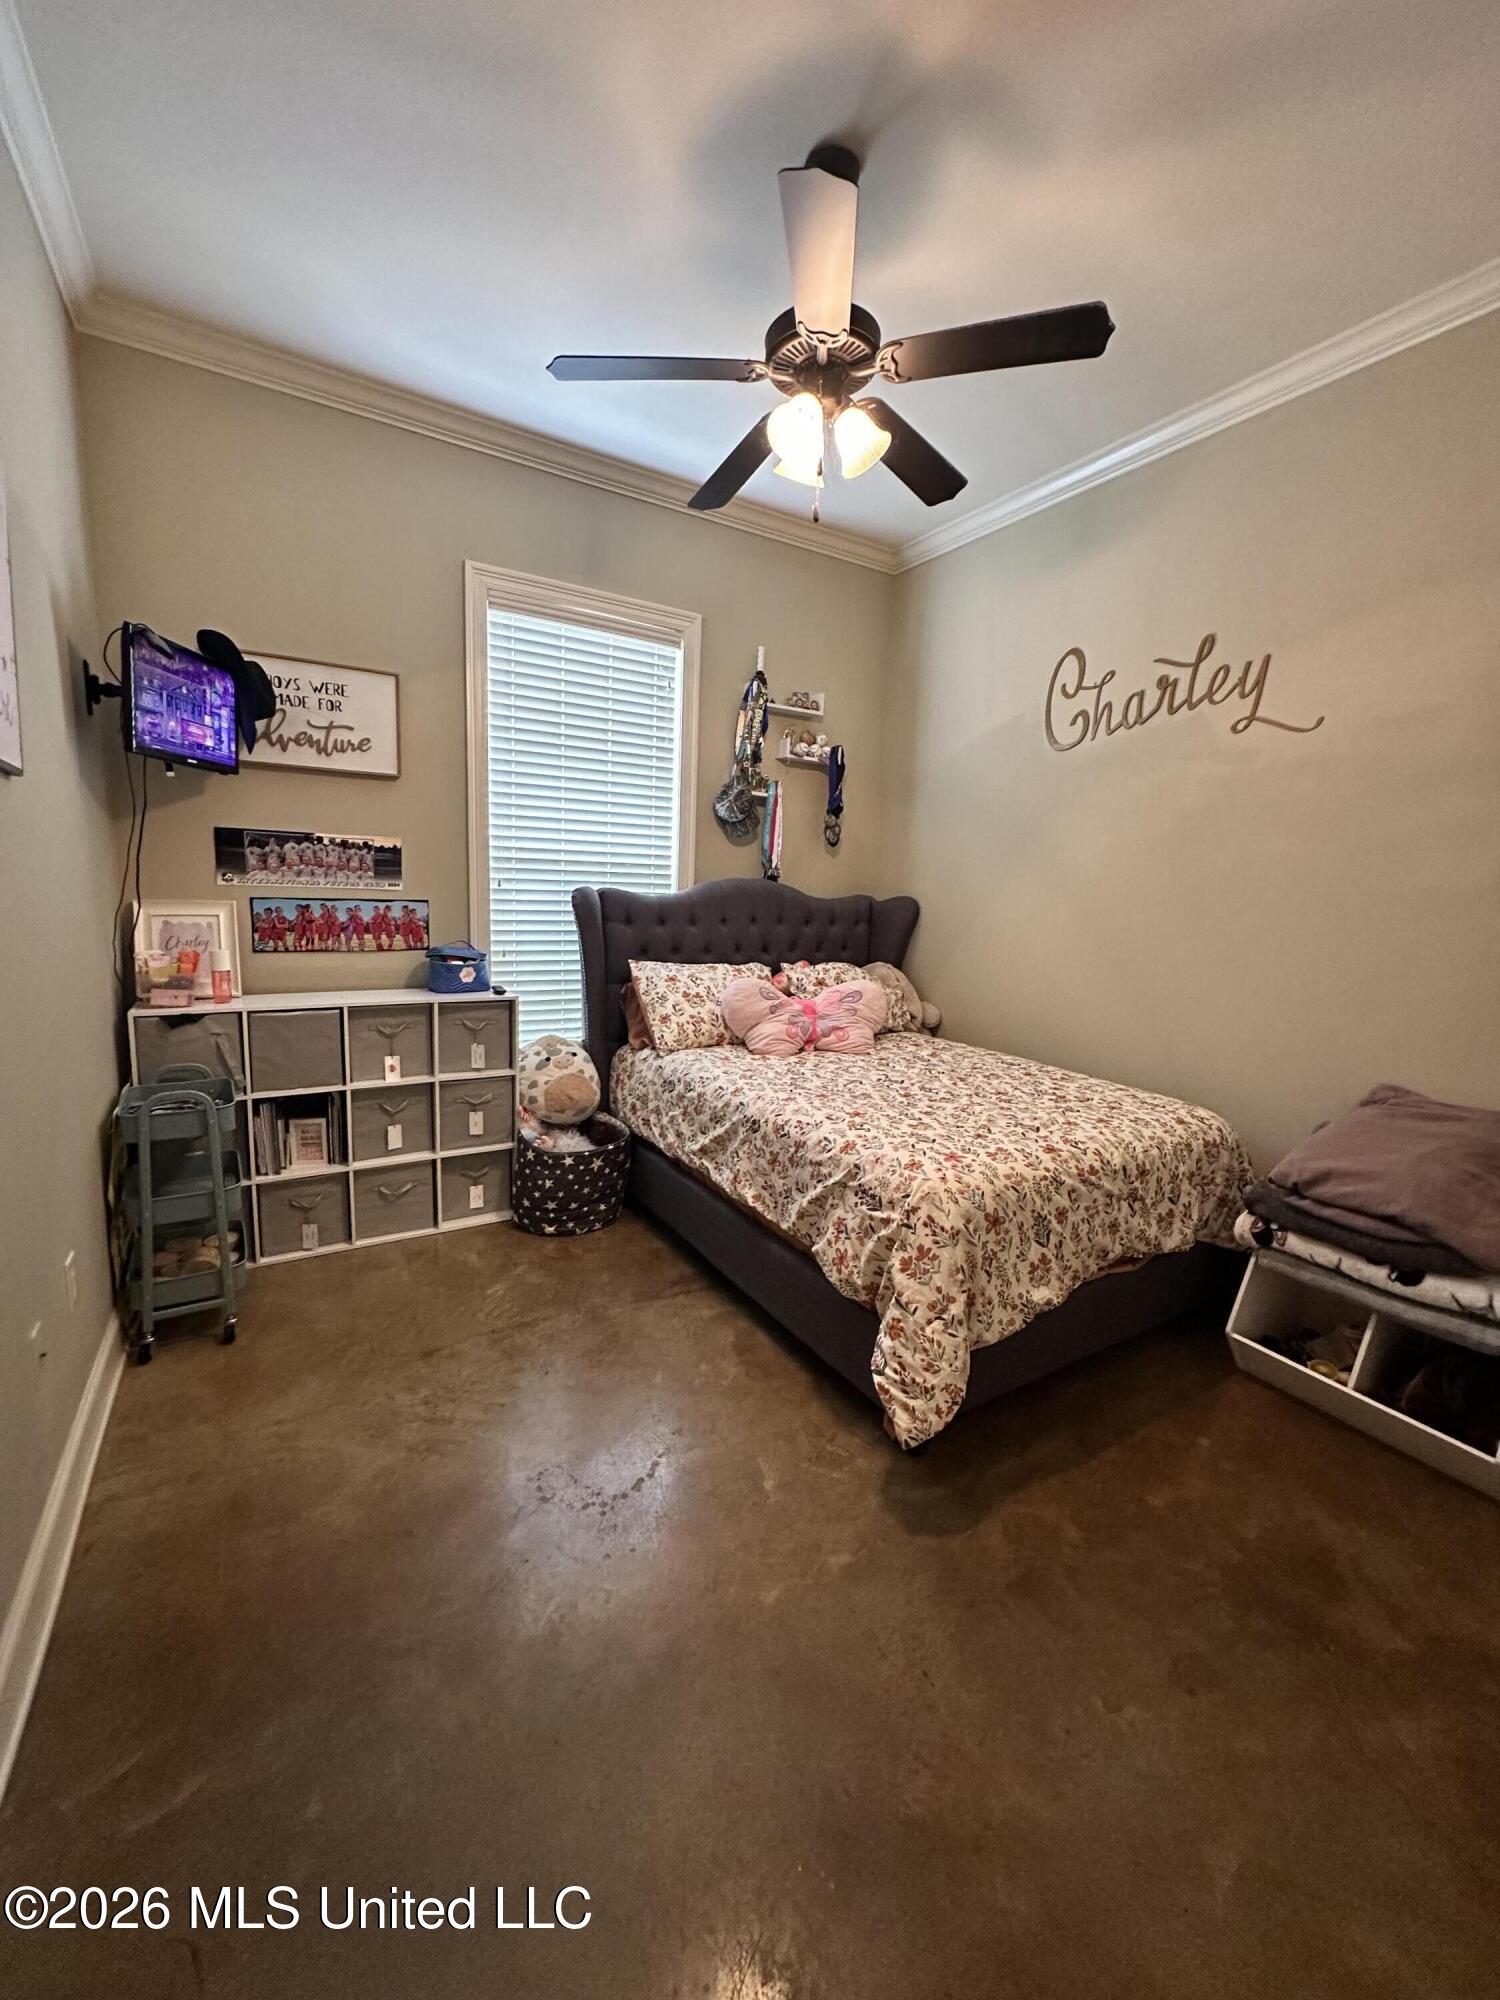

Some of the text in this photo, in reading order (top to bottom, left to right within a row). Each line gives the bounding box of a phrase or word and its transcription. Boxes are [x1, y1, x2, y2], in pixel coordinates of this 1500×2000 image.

[266, 674, 350, 698] OYS WERE
[1045, 632, 1325, 752] Charley
[318, 697, 343, 712] FOR
[256, 708, 372, 757] dventure
